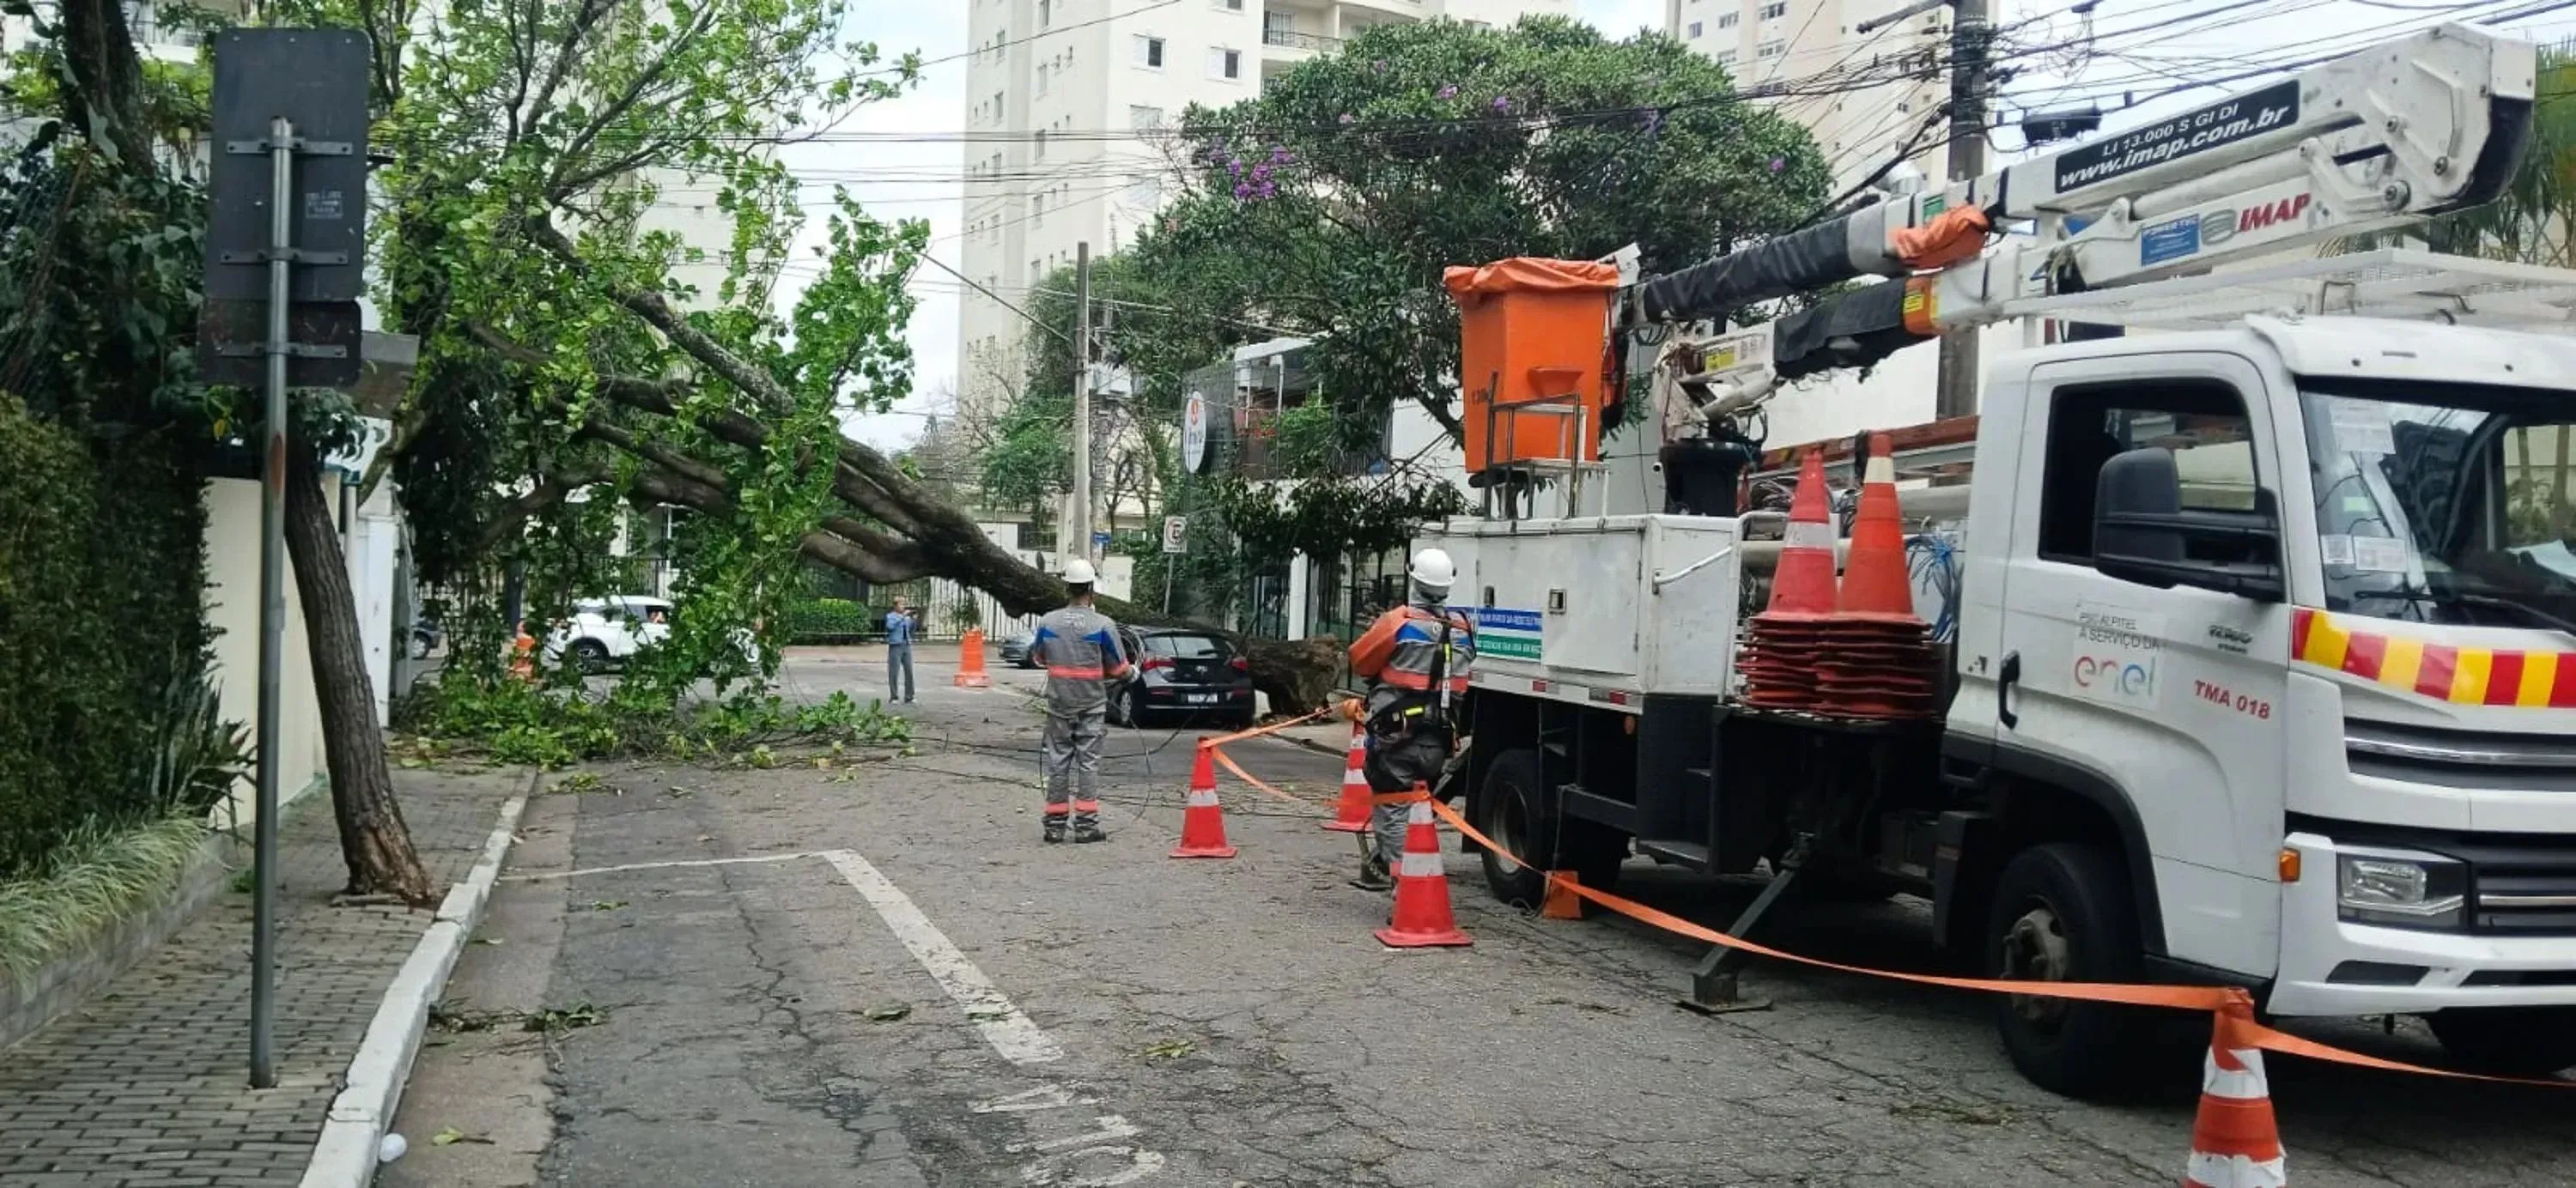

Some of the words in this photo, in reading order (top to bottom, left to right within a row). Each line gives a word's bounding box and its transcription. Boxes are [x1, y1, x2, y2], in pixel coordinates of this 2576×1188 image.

[2059, 104, 2290, 187] www.imap.com.br
[2102, 142, 2118, 157] LI
[2122, 124, 2174, 151] 13.000
[2178, 118, 2190, 132] S
[2238, 192, 2312, 233] IMAP
[2089, 627, 2141, 650] SERVIÇO
[2074, 655, 2157, 699] enel
[2194, 679, 2231, 708] TMA
[2235, 694, 2271, 719] 018
